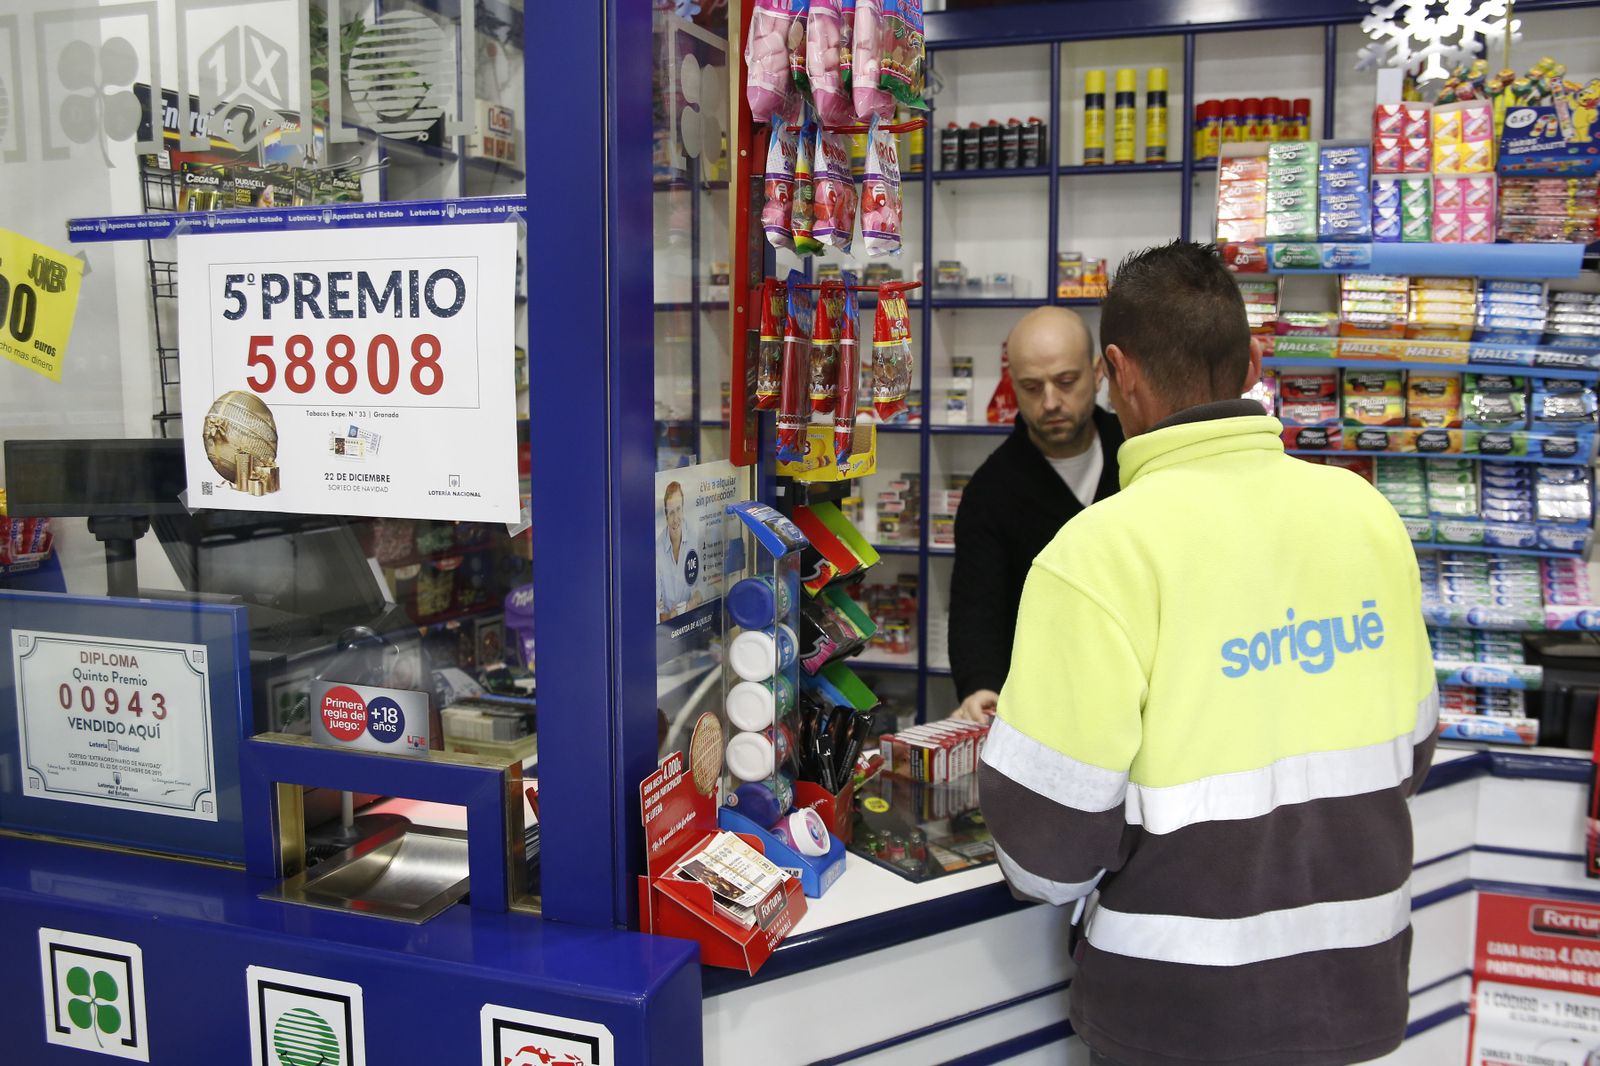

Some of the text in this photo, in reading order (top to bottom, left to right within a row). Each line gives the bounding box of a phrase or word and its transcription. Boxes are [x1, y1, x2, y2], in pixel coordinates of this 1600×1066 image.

[186, 173, 219, 185] CEGASA
[235, 178, 266, 188] DURACELL
[288, 214, 317, 222] Loterías
[332, 212, 365, 221] Apuestas
[366, 211, 378, 219] del
[379, 210, 404, 218] Estado
[409, 209, 440, 217] Loterías
[456, 207, 490, 216] Apuestas
[108, 222, 136, 230] Apuestas
[202, 219, 208, 227] y
[216, 217, 244, 225] Apuestas
[245, 216, 259, 224] del
[260, 216, 283, 224] Estado
[27, 253, 68, 293] JOKER
[261, 268, 466, 320] PREMIO
[34, 339, 57, 357] euros
[1277, 342, 1316, 352] HALLS
[1341, 343, 1378, 353] HALLS
[1406, 346, 1449, 357] HALLS
[13, 348, 29, 361] mas
[31, 355, 53, 372] dinero
[1472, 348, 1519, 360] HALLS
[1538, 352, 1588, 364] HALLS
[246, 333, 445, 396] 58808
[324, 473, 391, 483] 22 DE DICIEMBRE
[716, 477, 736, 491] alquilar
[362, 485, 389, 493] NAVIDAD
[695, 496, 705, 507] sin
[80, 651, 139, 669] DIPLOMA
[72, 667, 148, 687] Quinto Premio
[59, 683, 167, 720] 00943
[325, 697, 363, 711] Primera
[323, 709, 366, 721] regla del
[371, 707, 398, 724] +18
[67, 716, 161, 741] VENDIDO AQUÍ
[329, 719, 360, 731] juego:
[372, 721, 397, 733] años
[761, 891, 782, 918] Fortuna
[1487, 941, 1518, 956] GANA
[1519, 945, 1556, 962] HASTA
[1486, 960, 1586, 985] PARTICIPACIÓN DE
